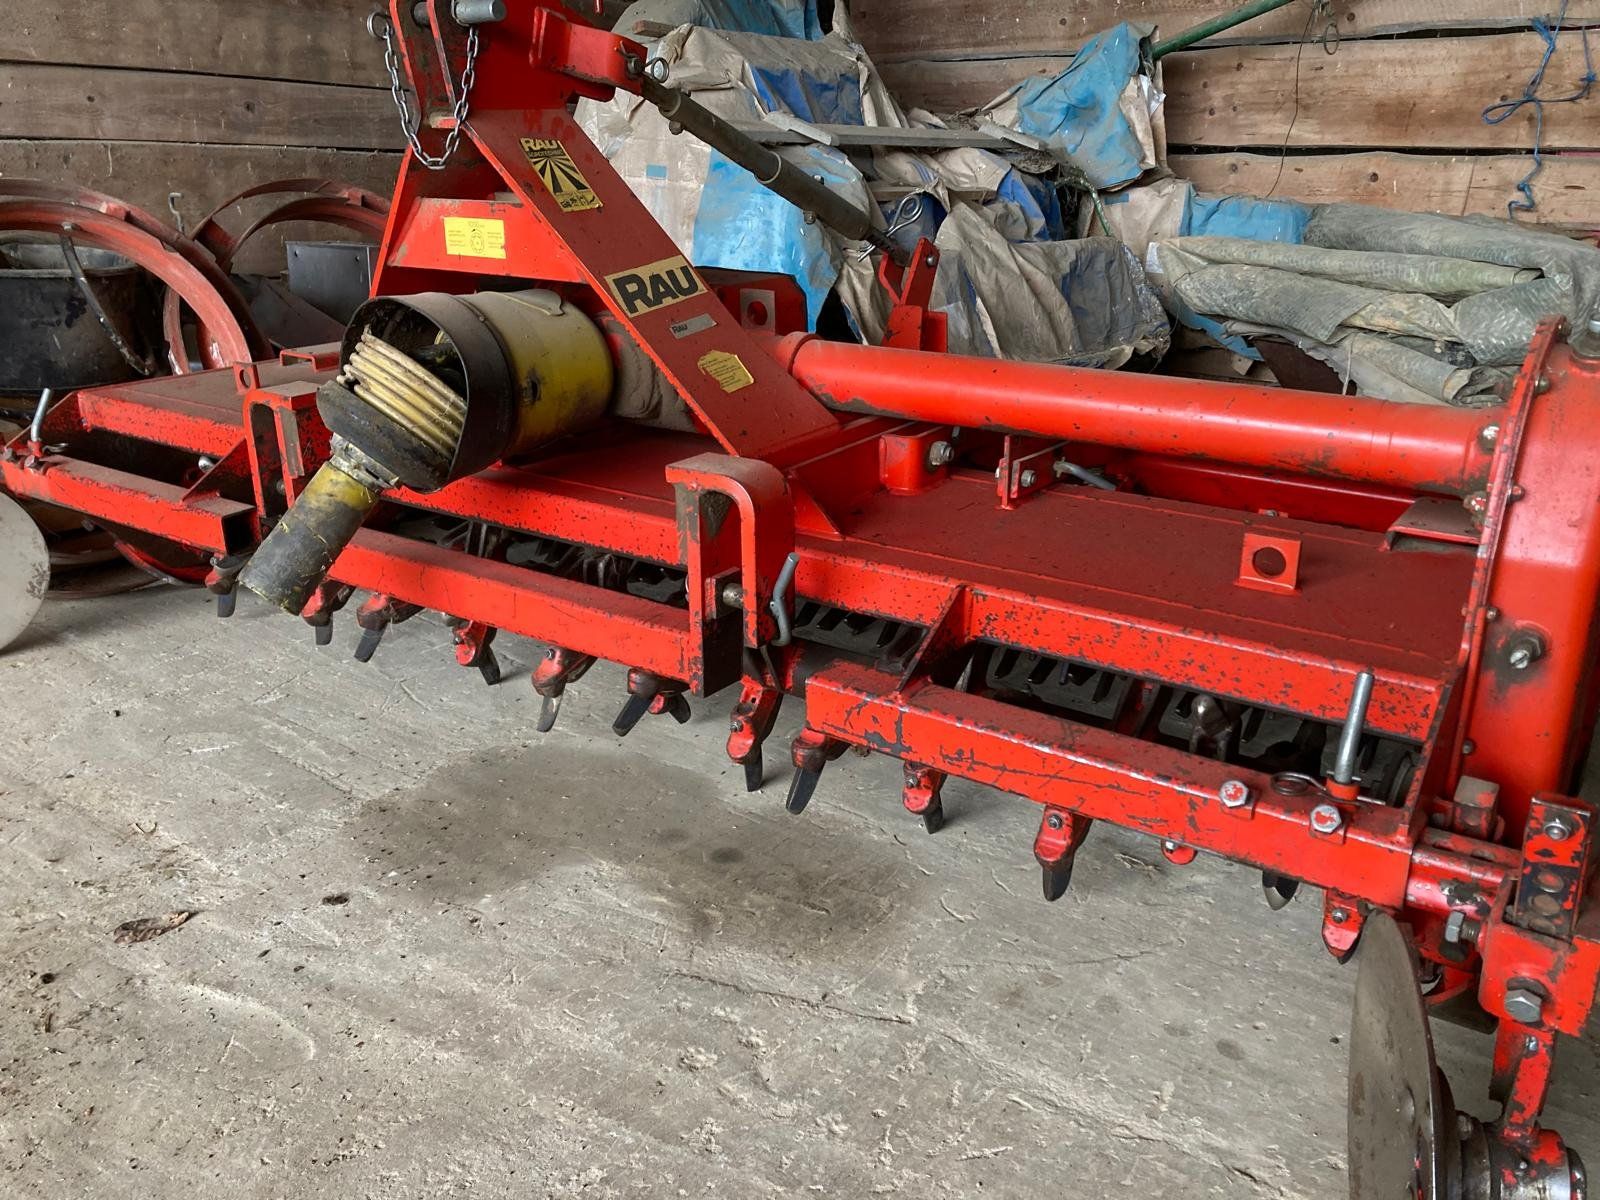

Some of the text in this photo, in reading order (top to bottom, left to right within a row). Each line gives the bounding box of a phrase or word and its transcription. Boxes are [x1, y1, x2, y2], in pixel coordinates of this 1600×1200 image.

[520, 137, 558, 151] RAU
[612, 265, 699, 314] RAU
[671, 323, 688, 333] RAU
